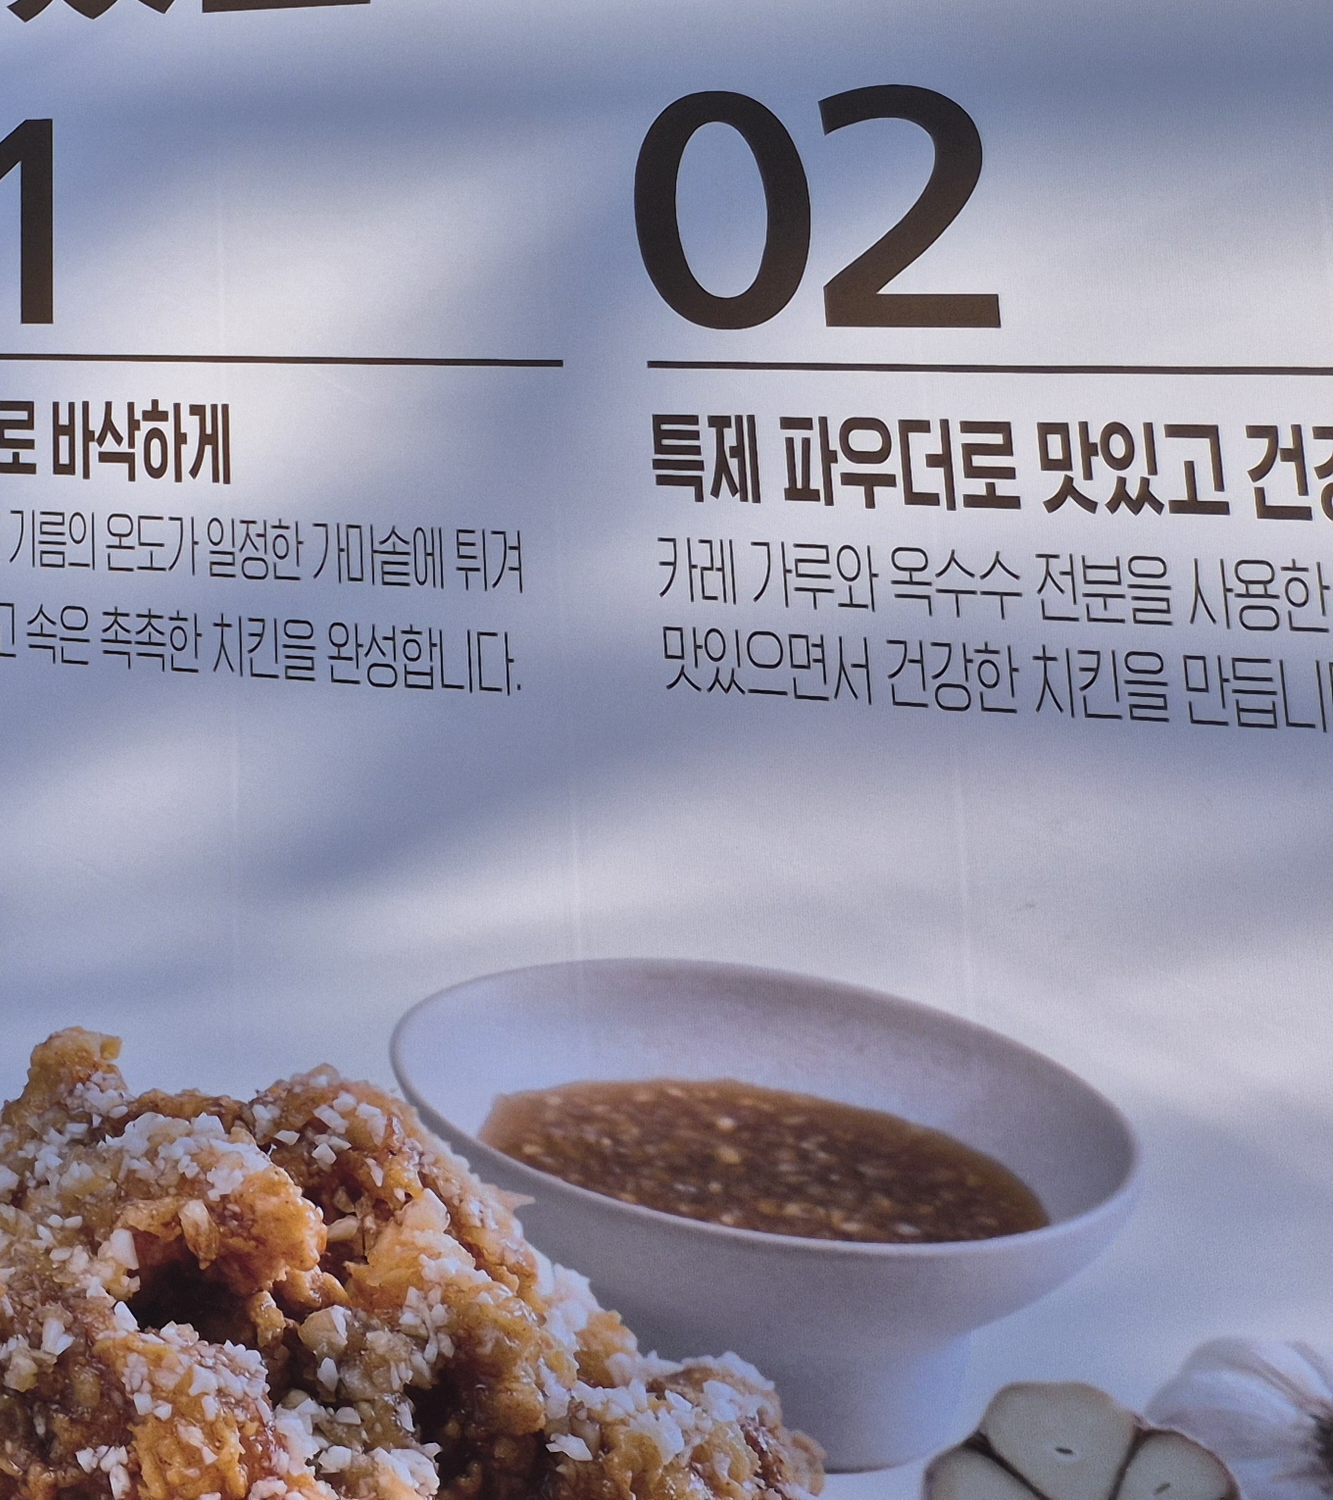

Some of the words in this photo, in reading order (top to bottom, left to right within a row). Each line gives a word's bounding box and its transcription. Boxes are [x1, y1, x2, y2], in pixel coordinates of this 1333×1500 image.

[634, 84, 1001, 330] 02
[52, 400, 232, 485] 바삭하게
[652, 414, 762, 503] 특제
[779, 416, 1022, 511] 파우더로
[1037, 420, 1231, 516] 맛있고
[8, 507, 97, 571] 기름의
[106, 511, 200, 576] 온도가
[206, 517, 304, 582] 일정한
[313, 521, 445, 590] 가마솥에
[455, 528, 524, 593] 튀겨
[658, 537, 737, 605] 카레
[750, 540, 880, 613] 가루와
[889, 546, 1023, 620] 옥수수
[1035, 553, 1174, 626] 전분을
[1189, 558, 1331, 633] 사용한
[26, 604, 91, 665] 속은
[101, 606, 202, 674] 촉촉한
[213, 612, 316, 682] 치킨을
[327, 621, 523, 695] 완성합니다.
[662, 626, 874, 706] 맛있으면서
[886, 637, 1019, 715] 건강한
[1033, 645, 1170, 722] 치킨을
[1182, 654, 1333, 734] 만듭니
